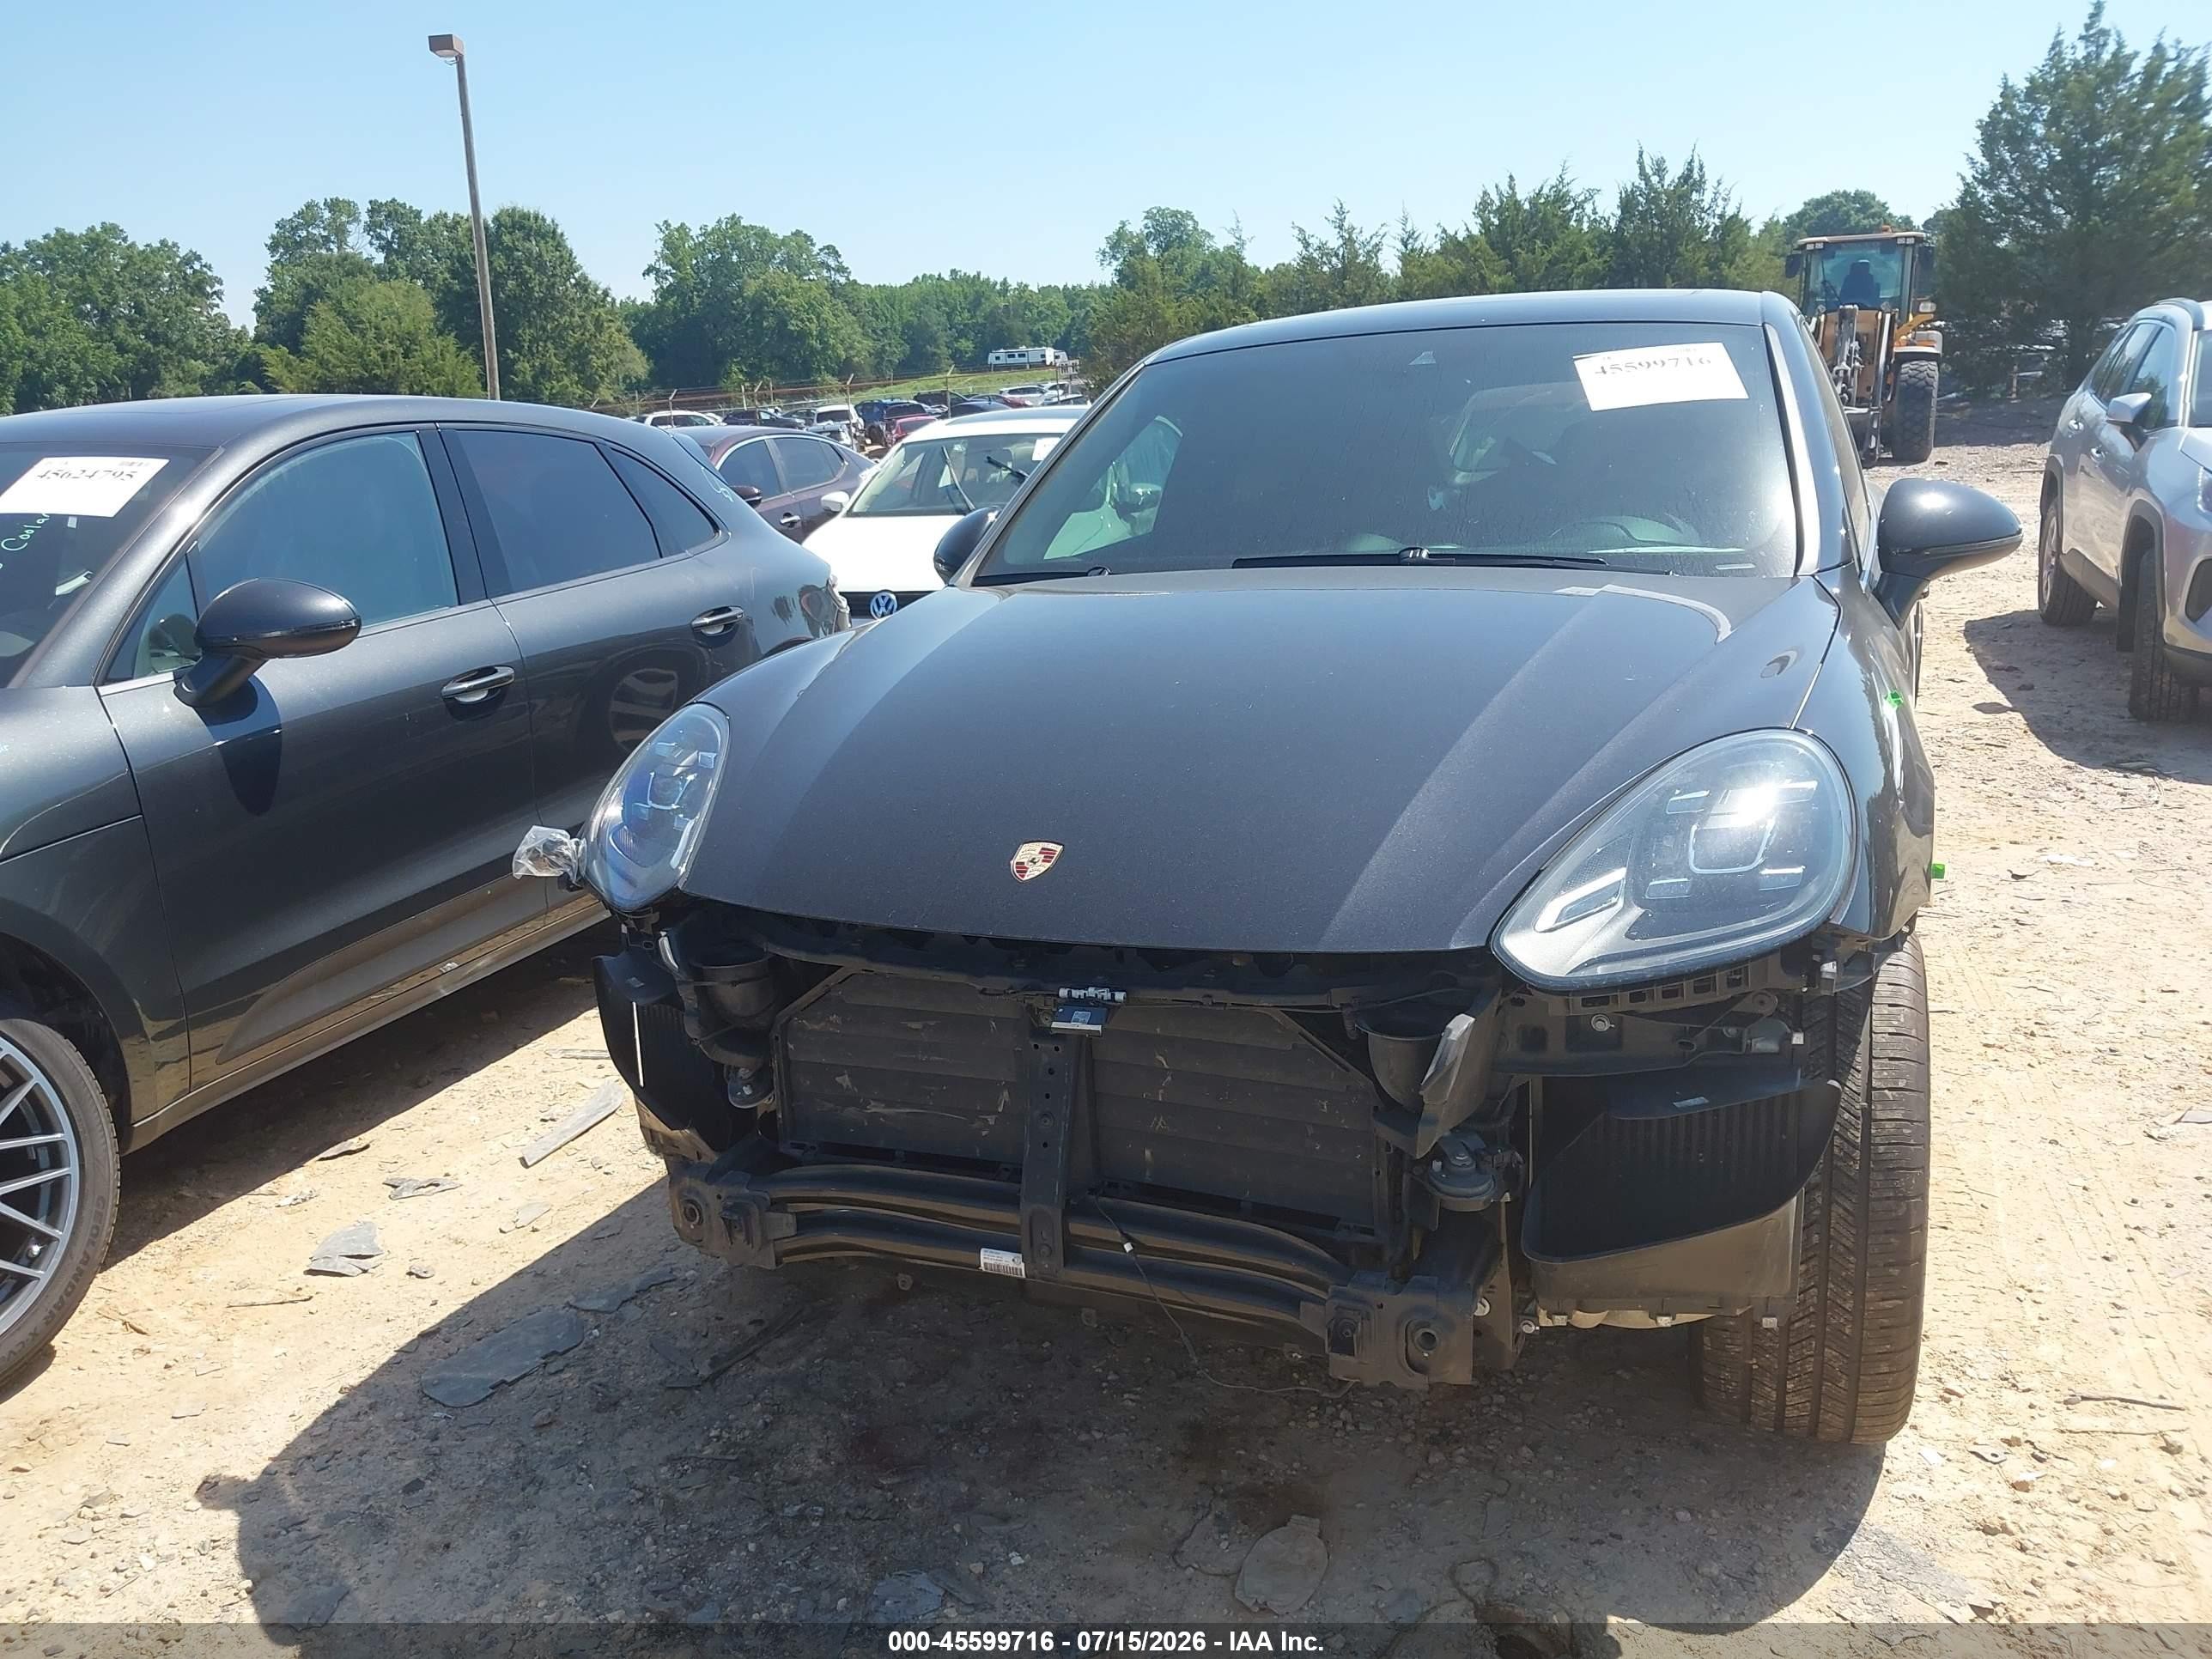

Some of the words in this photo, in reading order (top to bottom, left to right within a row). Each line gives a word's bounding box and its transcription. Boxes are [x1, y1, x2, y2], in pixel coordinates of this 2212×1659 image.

[1595, 356, 1711, 375] 45599716
[872, 593, 896, 618] VW
[43, 1194, 106, 1327] GEOLANDAR
